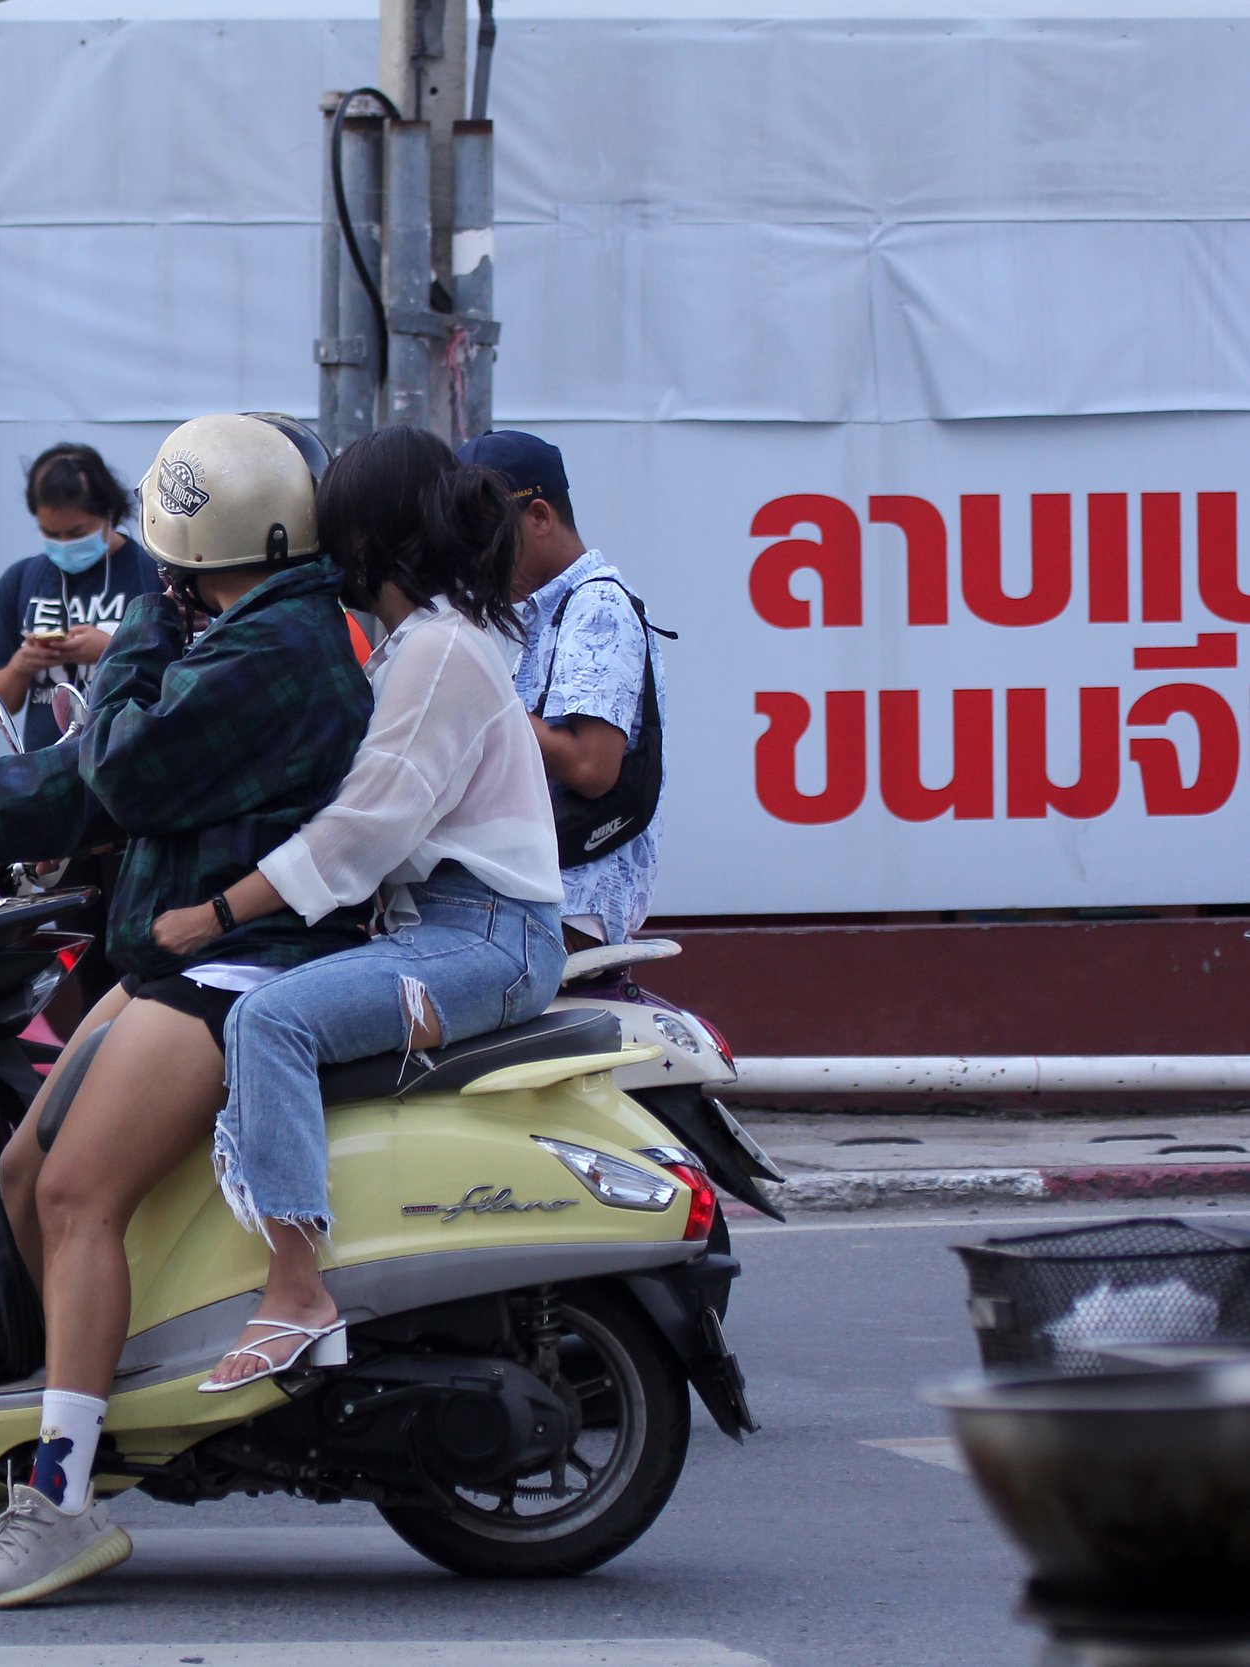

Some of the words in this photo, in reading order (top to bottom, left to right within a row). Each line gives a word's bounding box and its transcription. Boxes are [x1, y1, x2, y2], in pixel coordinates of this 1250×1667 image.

[172, 483, 193, 508] RIDER
[756, 633, 1250, 824] ขนมจี
[590, 816, 622, 842] NIKE
